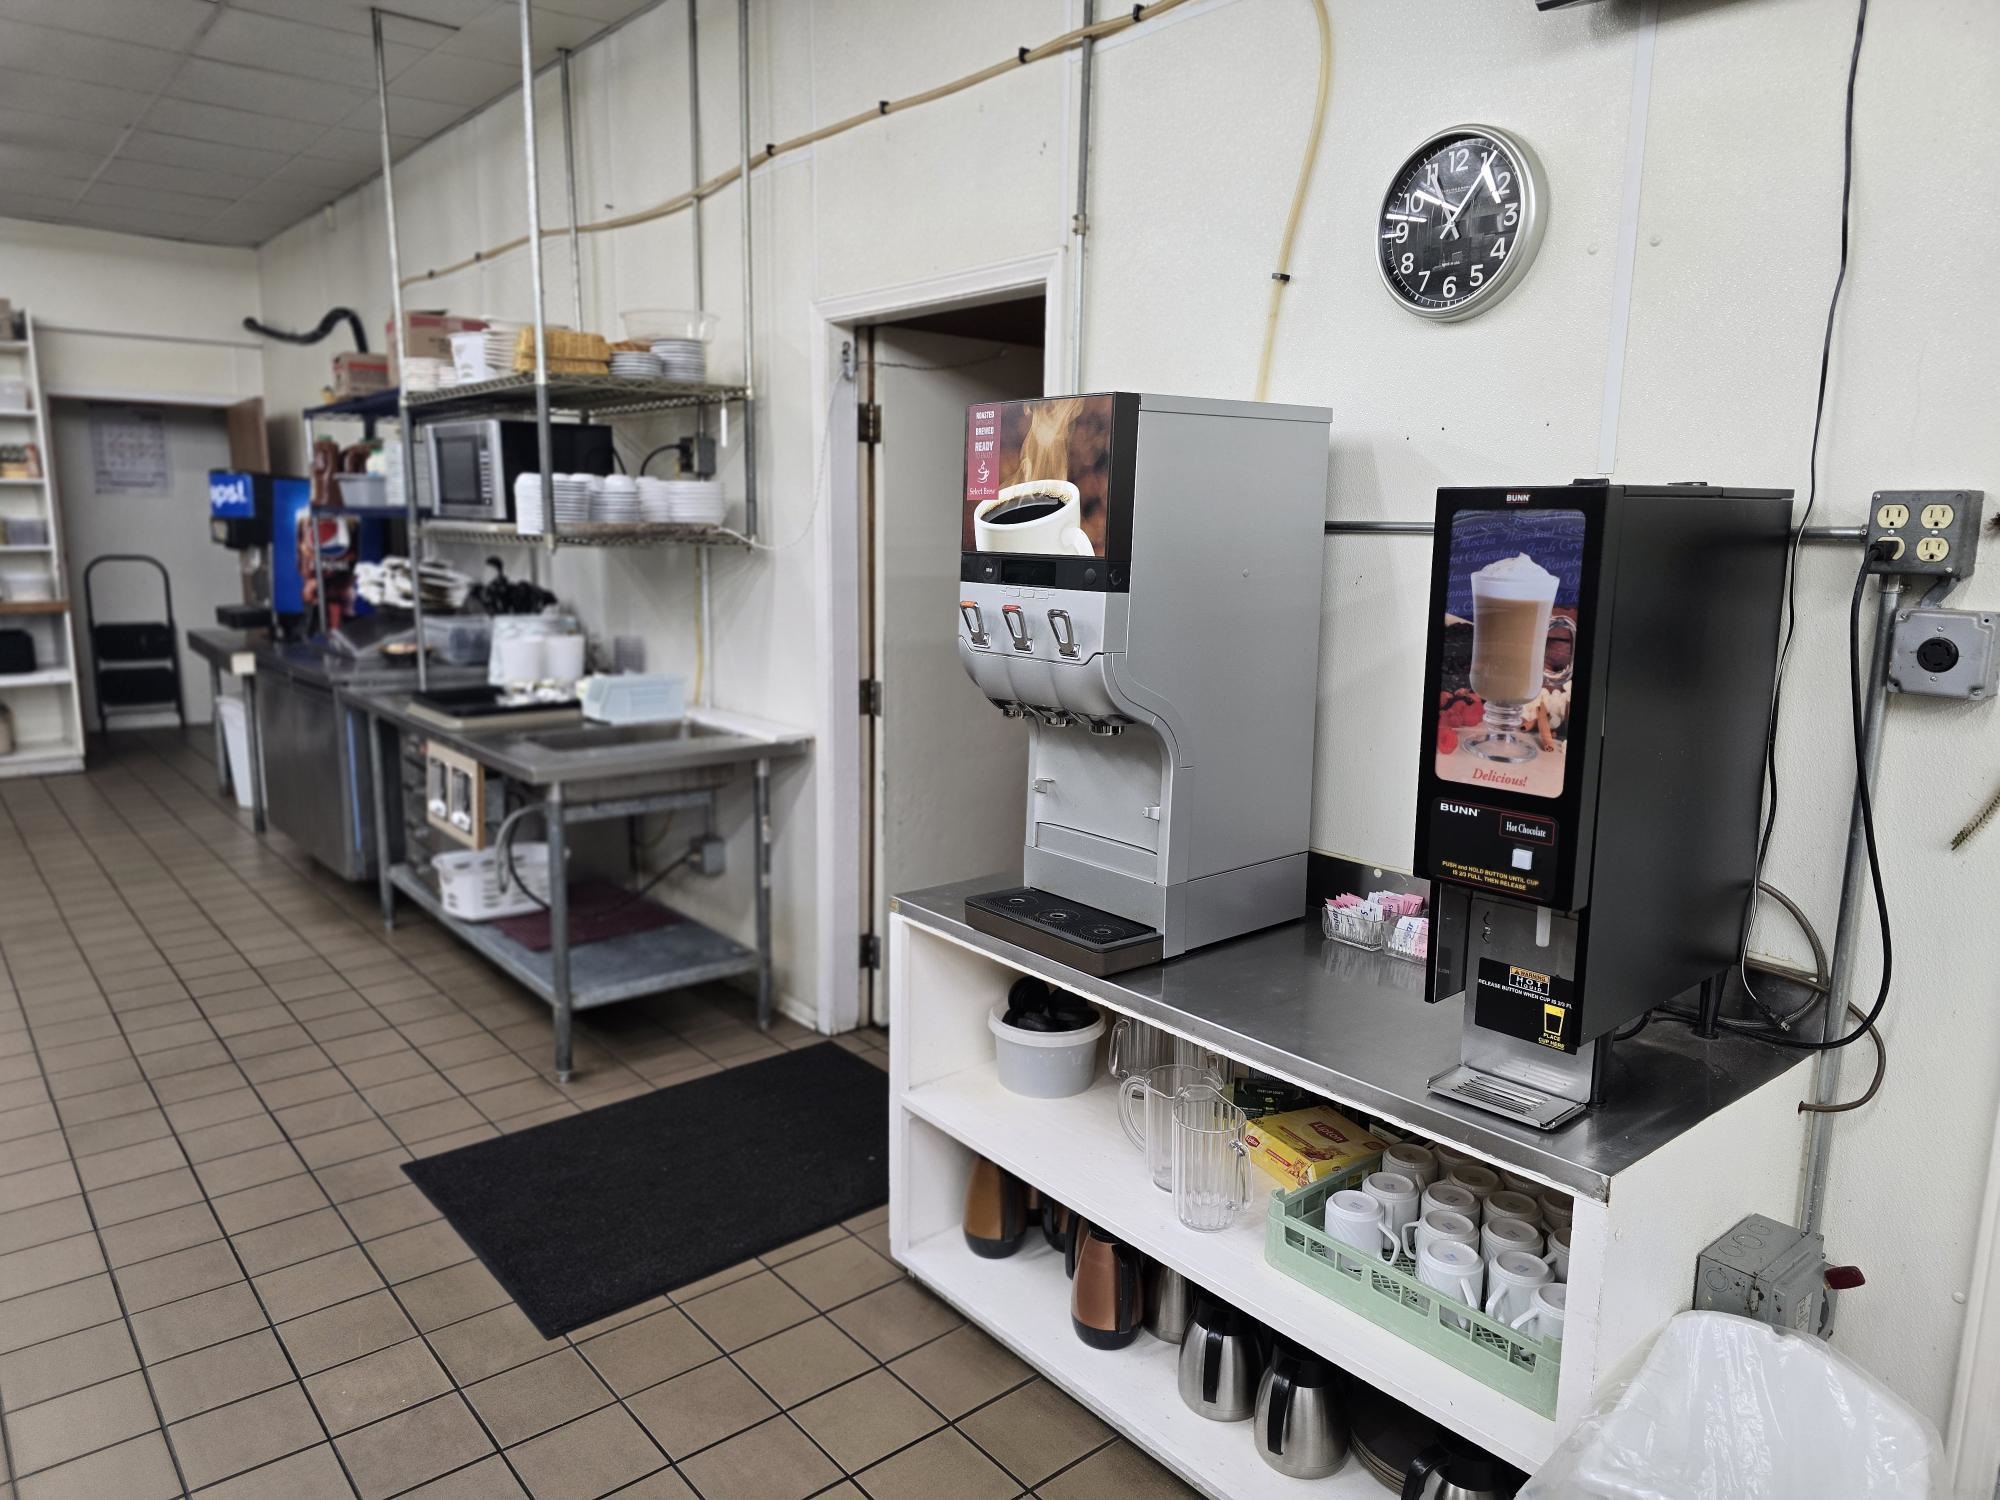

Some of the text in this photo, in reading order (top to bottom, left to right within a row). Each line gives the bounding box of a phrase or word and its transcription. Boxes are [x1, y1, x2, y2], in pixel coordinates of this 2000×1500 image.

[1449, 149, 1469, 172] 12
[1426, 163, 1438, 186] 11
[1497, 172, 1511, 194] 2
[1404, 193, 1424, 213] 10
[1504, 203, 1518, 226] 3
[1396, 222, 1409, 243] 9
[1490, 237, 1506, 259] 4
[1401, 253, 1414, 274] 8
[1418, 271, 1431, 292] 7
[1470, 264, 1484, 287] 5
[1442, 276, 1456, 298] 6
[975, 441, 994, 452] READY
[1506, 494, 1530, 502] BUNN
[1472, 768, 1528, 787] Delicious!
[1440, 803, 1479, 817] BUNN
[1506, 821, 1547, 838] Hot Chocolate
[1442, 860, 1457, 869] PUSH
[1468, 866, 1484, 875] HOLD
[1484, 869, 1508, 879] BUTTON
[1508, 873, 1526, 884] UNTIL
[1526, 878, 1540, 886] CUP
[1484, 876, 1500, 885] THEN
[1499, 880, 1527, 891] RELEASE
[1516, 975, 1543, 988] HOT
[1520, 971, 1547, 982] WARNING
[1478, 978, 1501, 989] RELEASE
[1501, 985, 1523, 995] BUTTON
[1523, 990, 1539, 1000] WHEN
[1539, 995, 1551, 1003] CUP
[1515, 982, 1542, 993] LIQUID
[1538, 1037, 1550, 1045] CUP
[1543, 1032, 1560, 1042] PLACE
[1246, 1135, 1259, 1147] Lipton
[1315, 1122, 1344, 1142] Lipton
